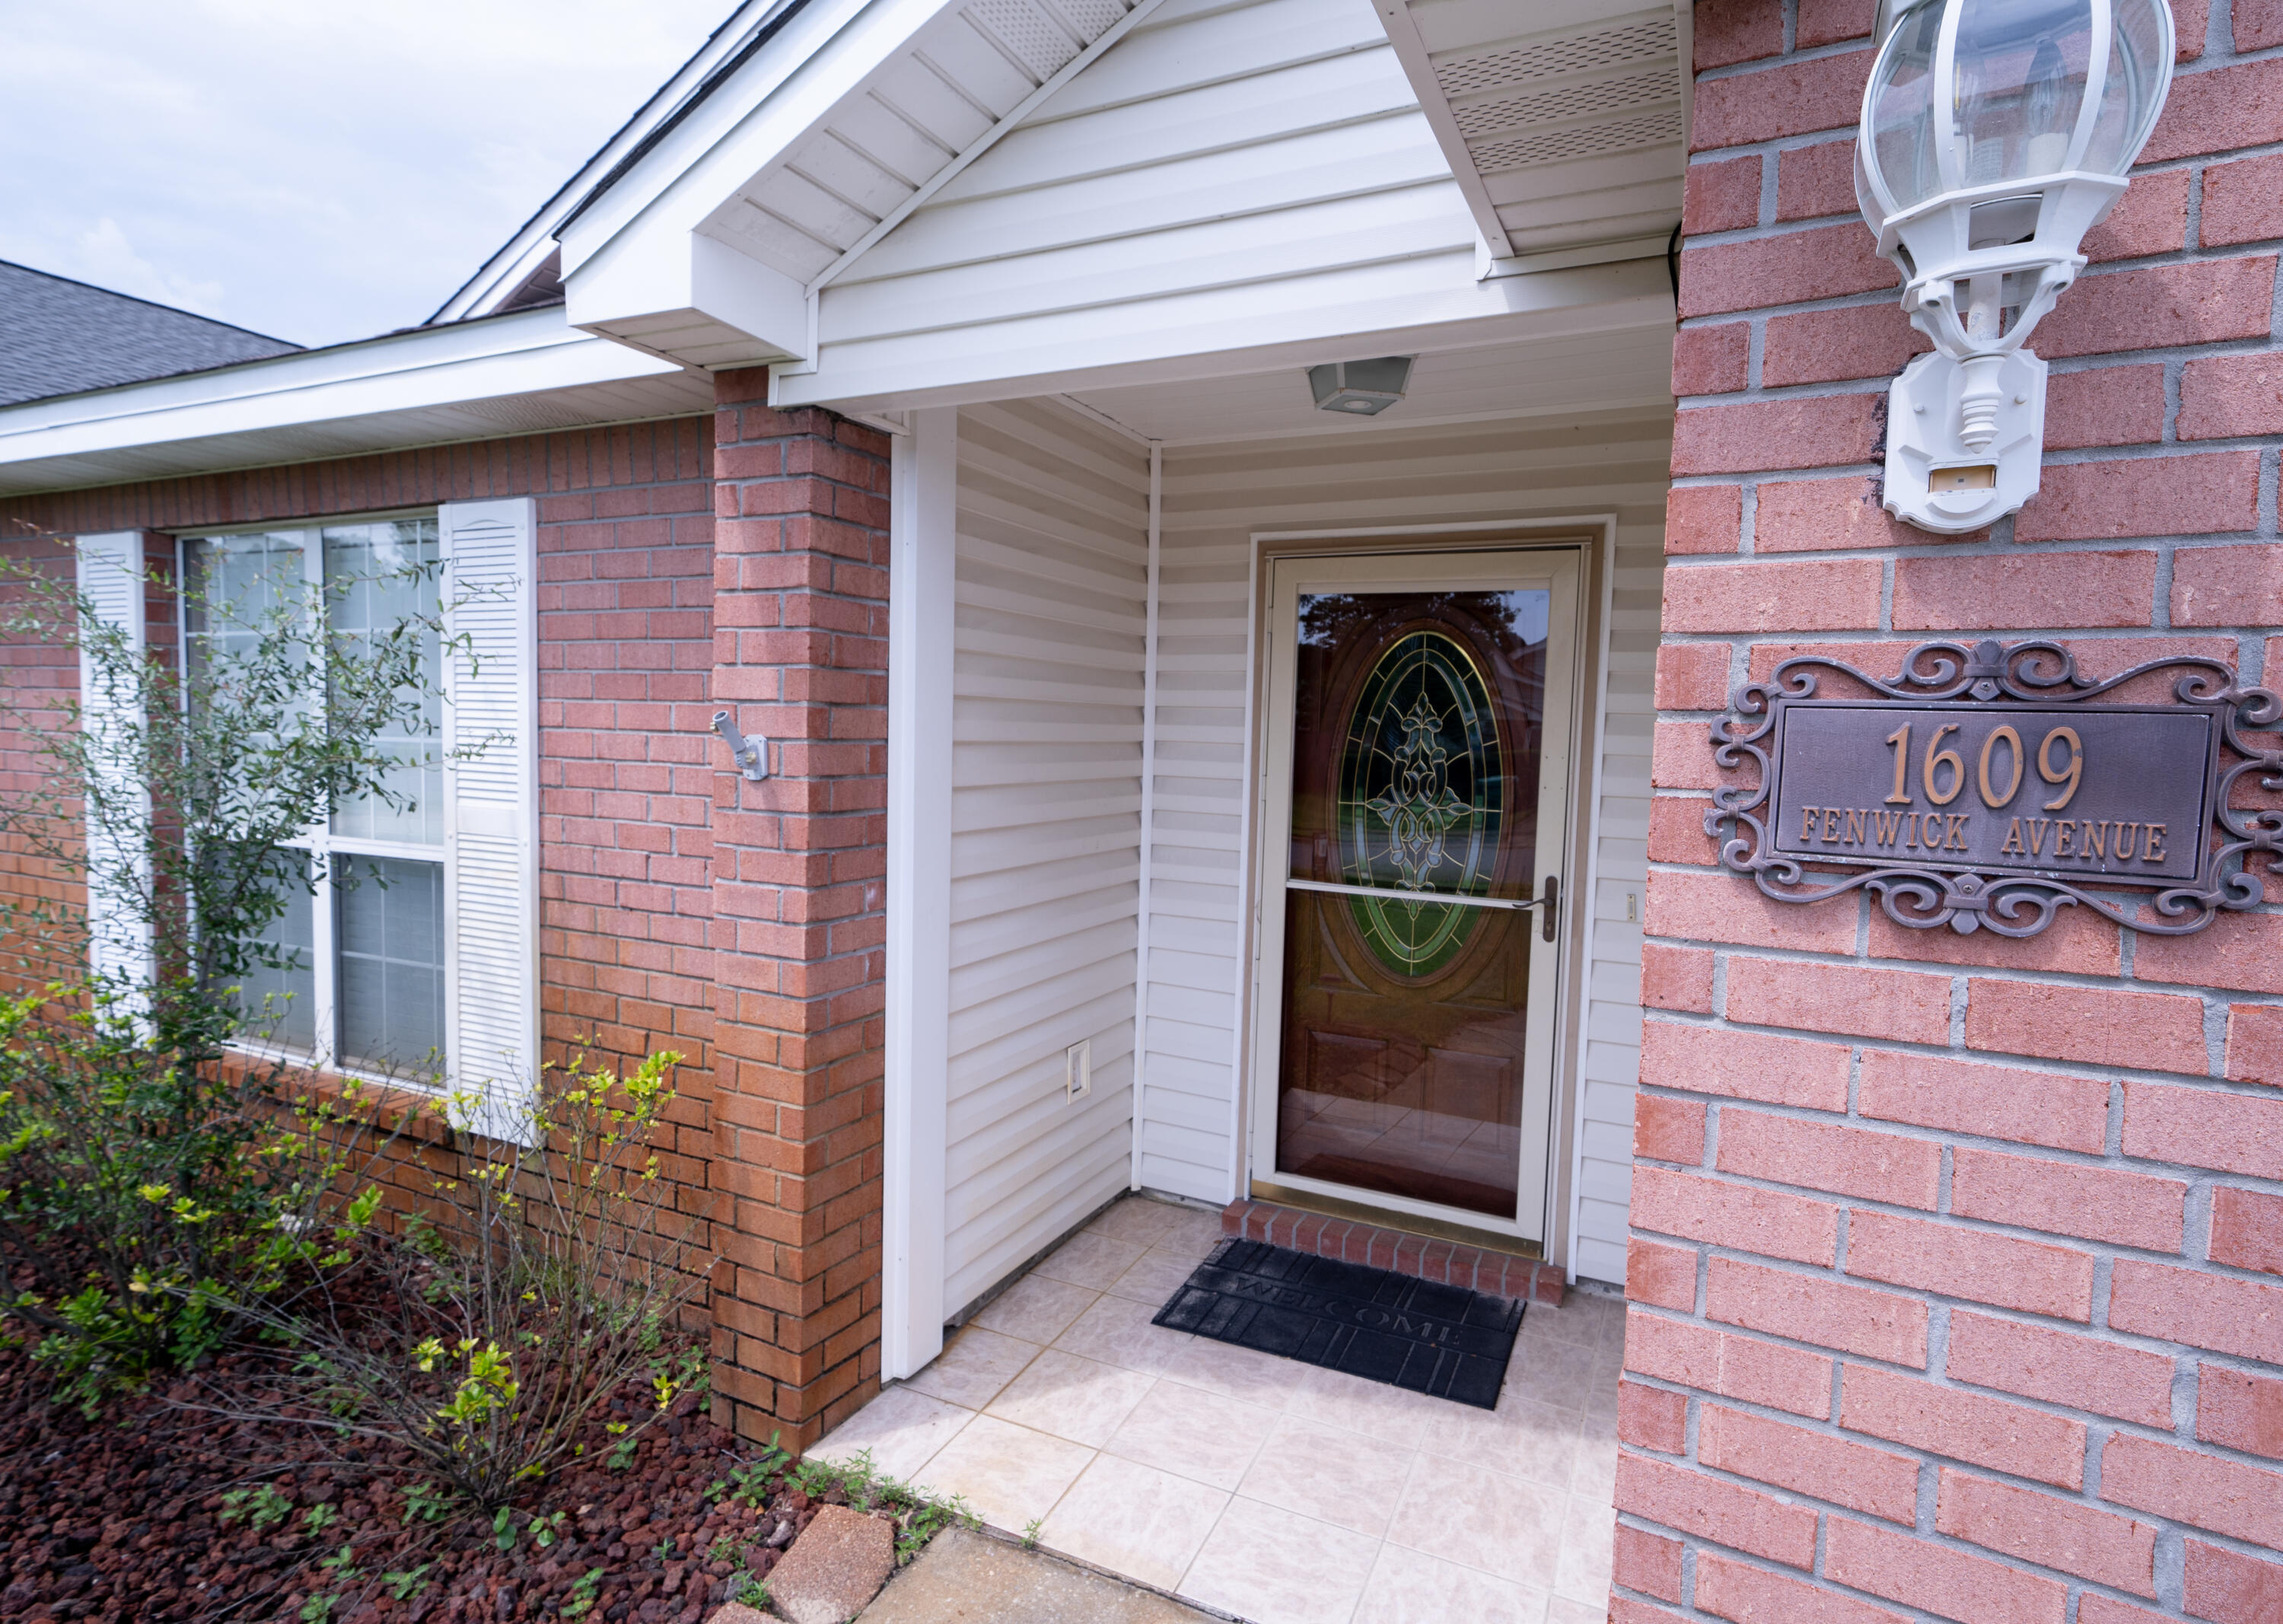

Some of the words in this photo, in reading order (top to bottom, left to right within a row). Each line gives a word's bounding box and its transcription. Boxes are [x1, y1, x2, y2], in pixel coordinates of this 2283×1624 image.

[1883, 722, 2084, 810] 1609
[1799, 807, 1969, 850] FENWICK
[2001, 817, 2167, 861] AVENUE
[1235, 1276, 1461, 1345] WELCOME
